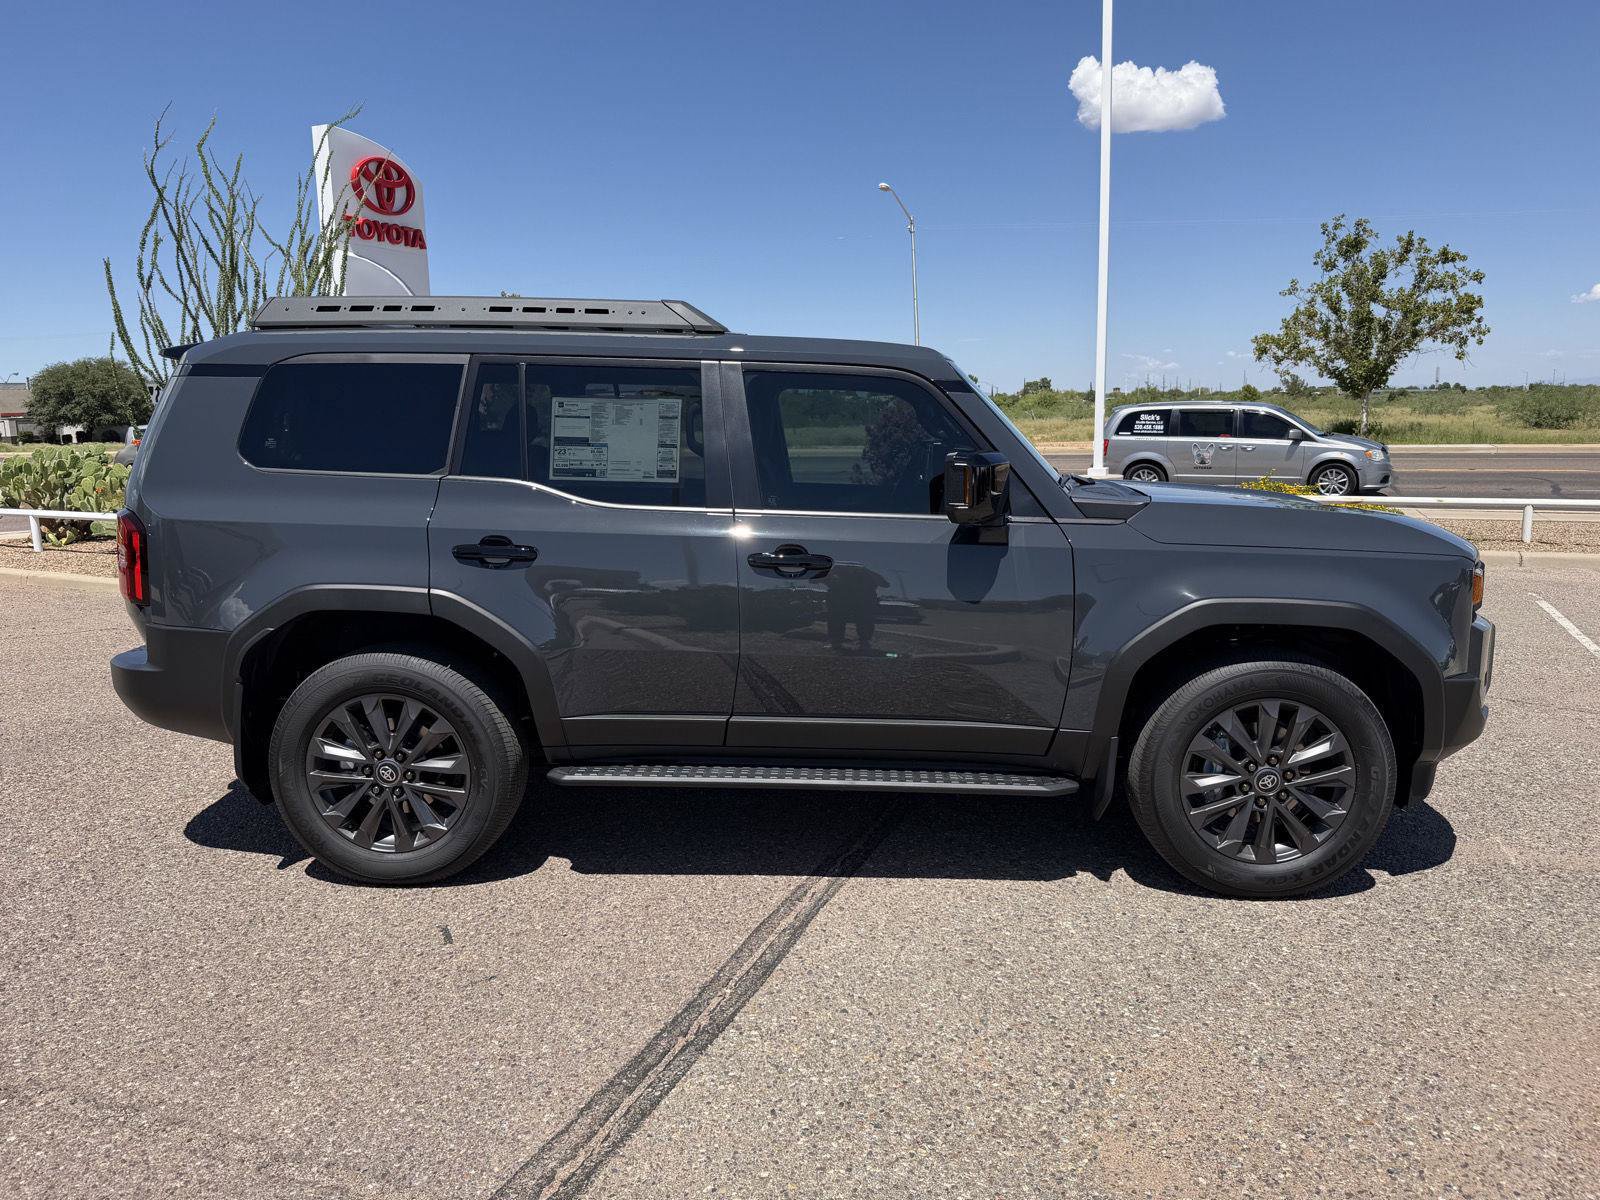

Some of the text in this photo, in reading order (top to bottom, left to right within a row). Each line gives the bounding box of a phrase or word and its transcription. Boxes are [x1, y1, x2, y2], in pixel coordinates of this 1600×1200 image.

[343, 214, 427, 249] TOYOTA
[1180, 678, 1258, 727] YOKOHAMA
[1310, 766, 1382, 876] GEOLANDAR
